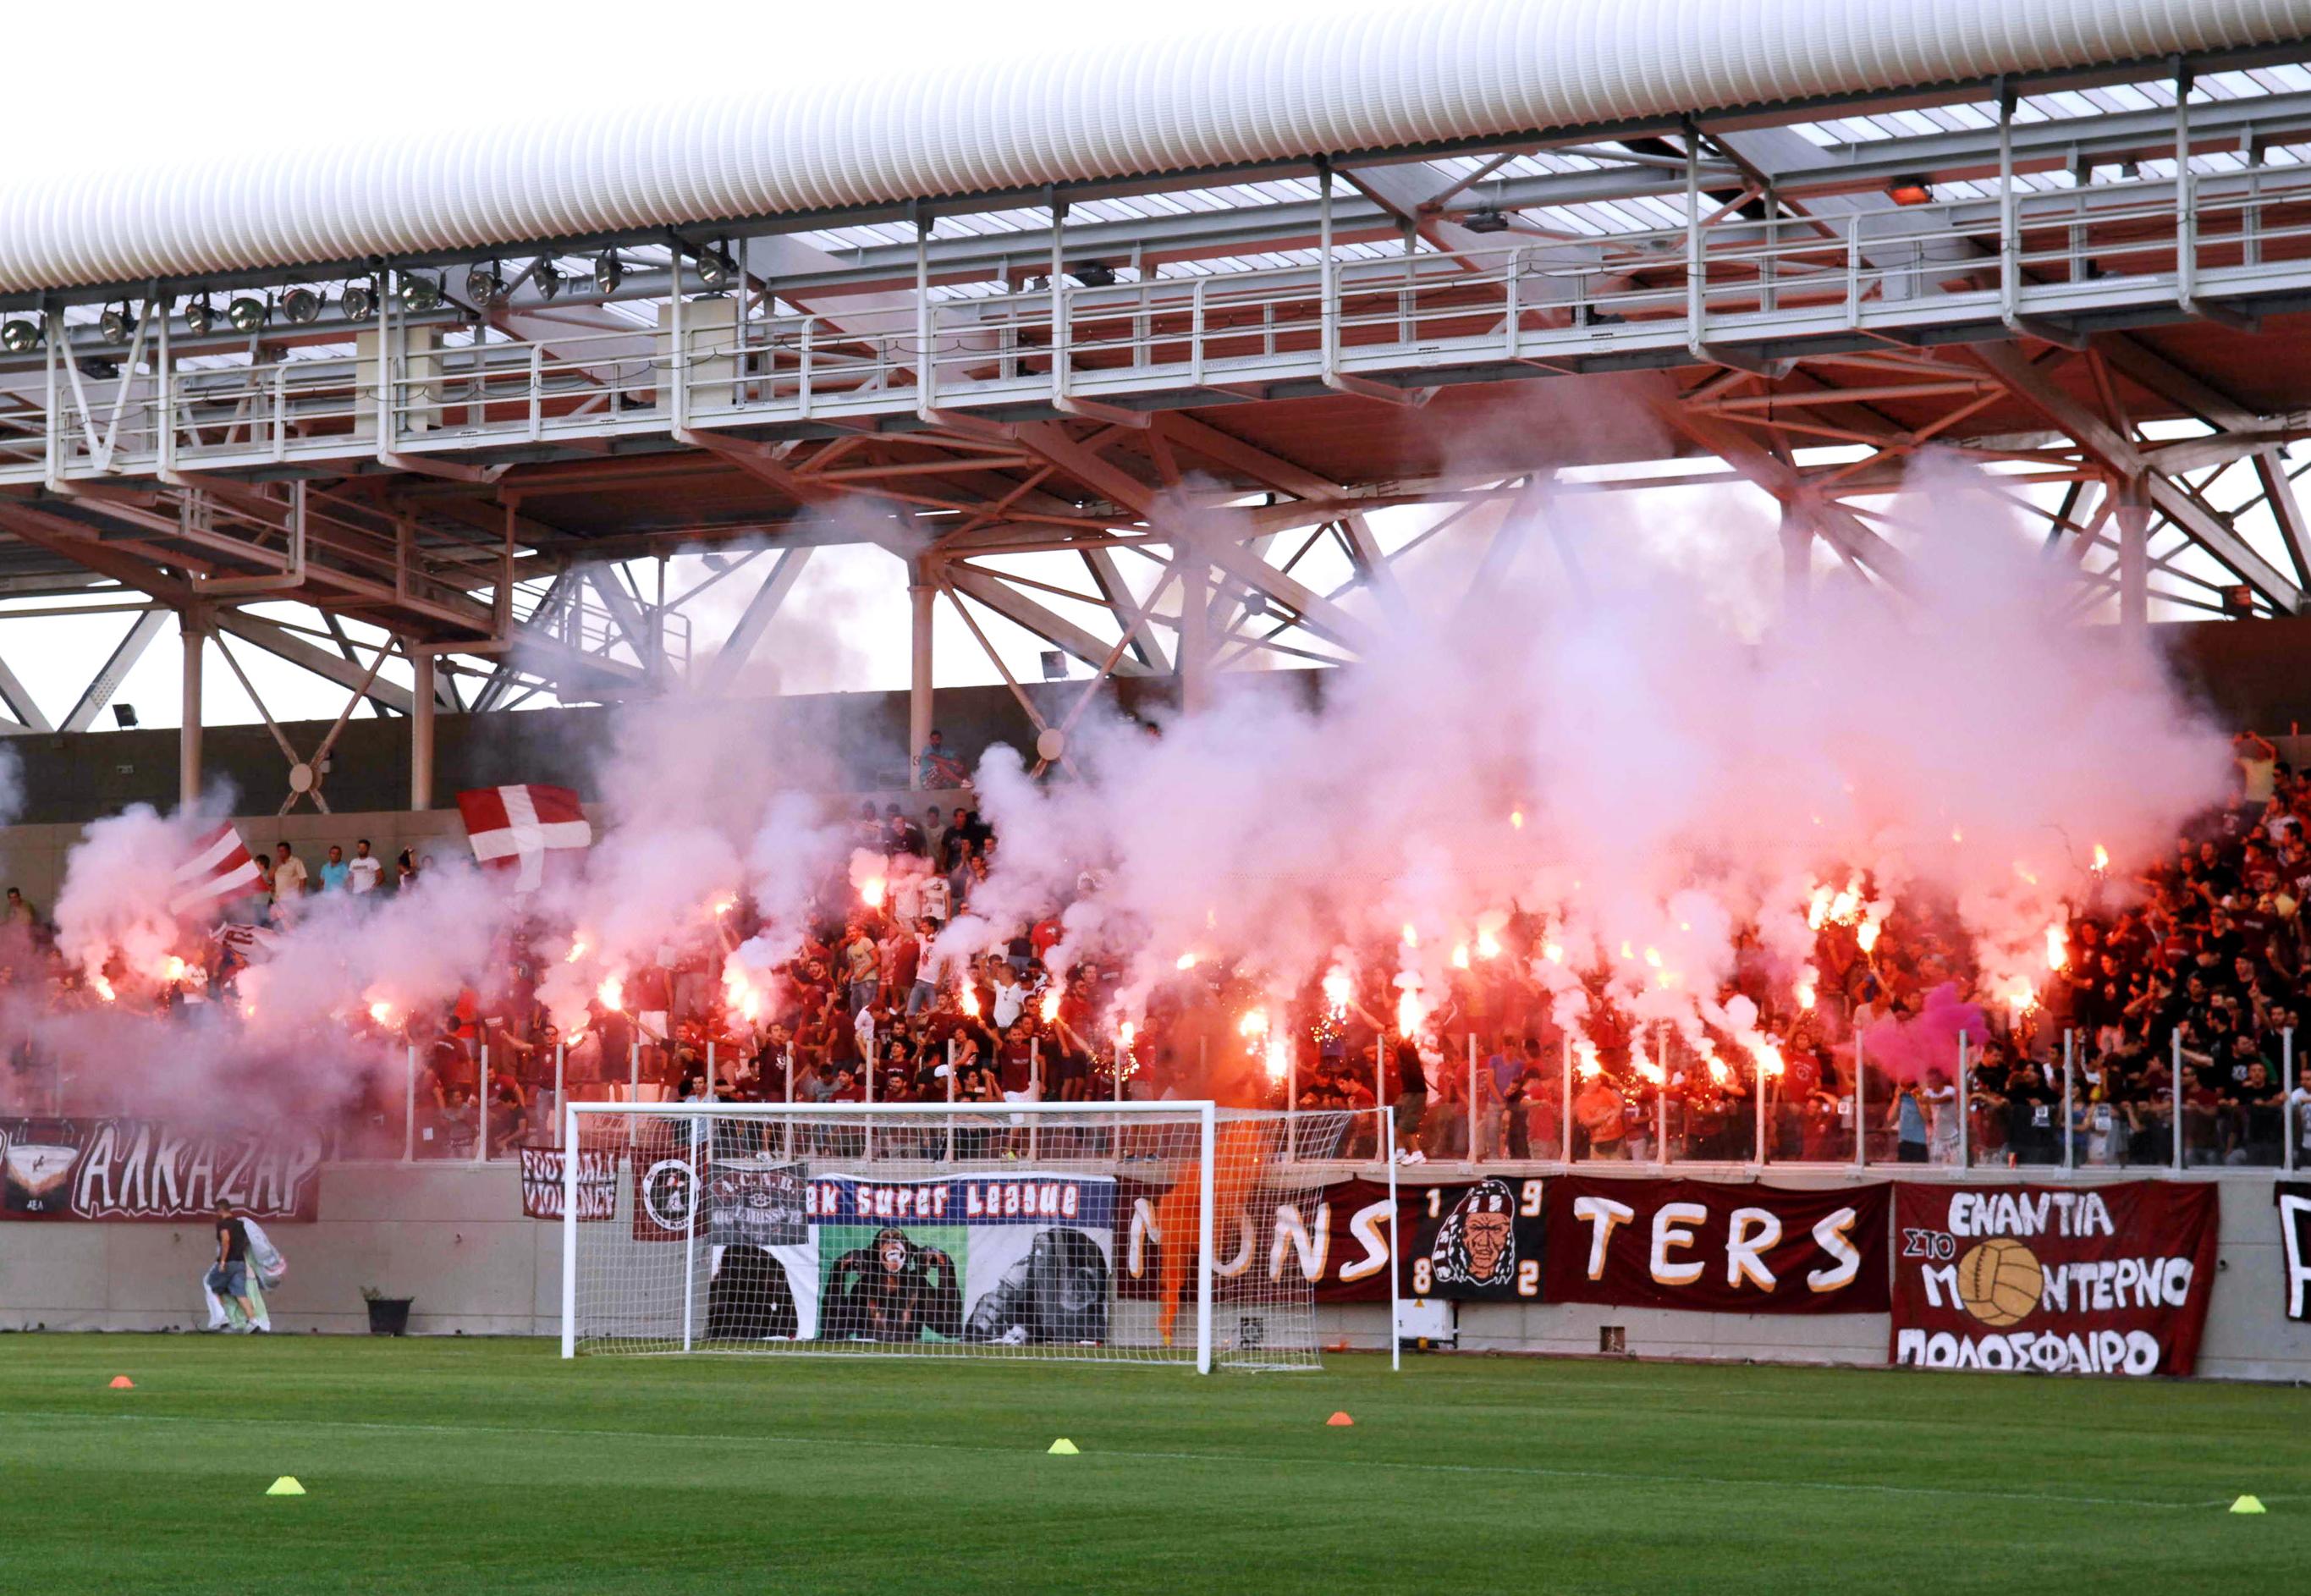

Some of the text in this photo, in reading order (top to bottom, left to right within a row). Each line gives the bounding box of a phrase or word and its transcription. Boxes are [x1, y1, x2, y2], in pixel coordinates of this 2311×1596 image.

[523, 1180, 615, 1217] VIOLNCE
[1426, 1180, 1543, 1219] 1 9
[1574, 1196, 1861, 1292] TERS
[1412, 1258, 1538, 1296] 8 2
